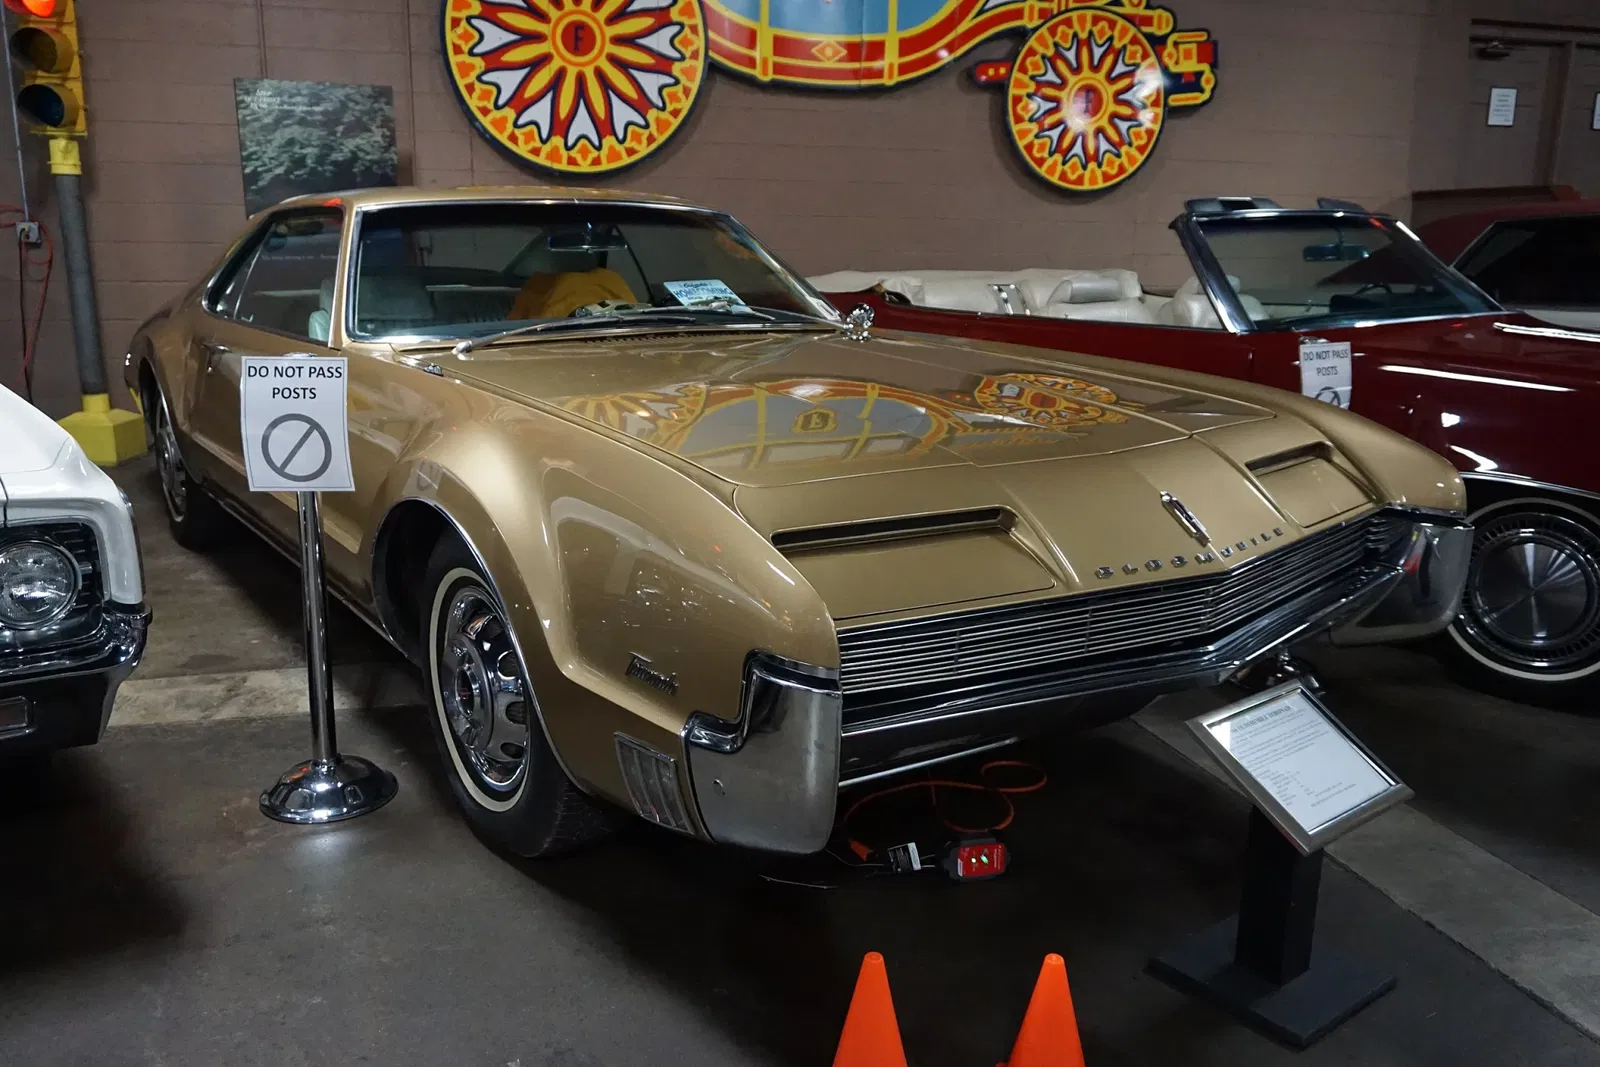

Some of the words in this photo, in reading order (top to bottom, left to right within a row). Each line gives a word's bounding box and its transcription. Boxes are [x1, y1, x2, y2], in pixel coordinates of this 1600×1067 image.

[573, 24, 585, 52] F
[1303, 351, 1314, 361] DO
[1316, 350, 1330, 360] NOT
[1332, 349, 1349, 359] PASS
[247, 365, 269, 378] DO
[273, 366, 304, 378] NOT
[308, 366, 342, 379] PASS
[1316, 366, 1339, 376] POSTS
[272, 387, 317, 399] POSTS
[1094, 527, 1284, 579] OLDSMOBILE
